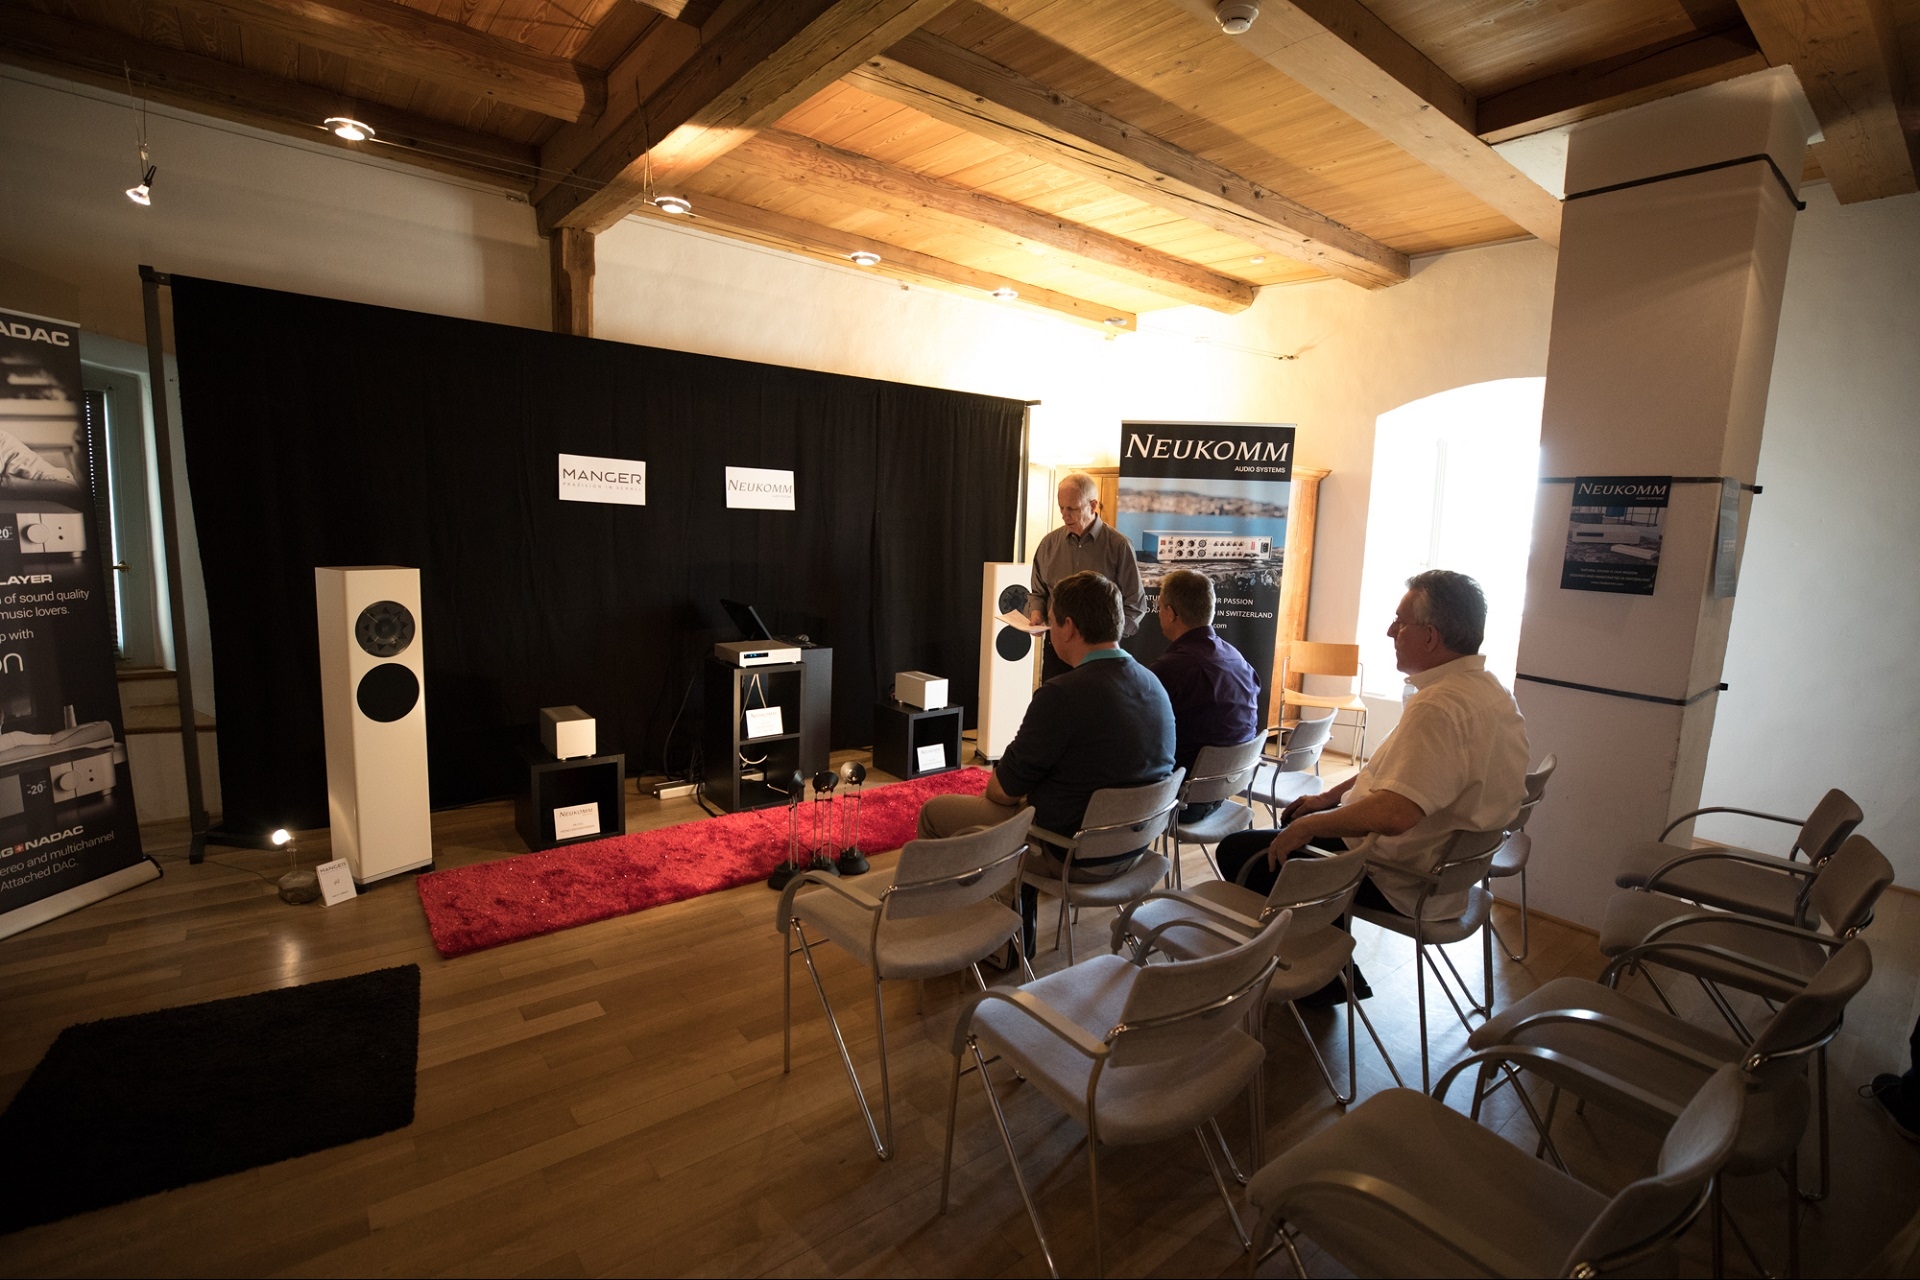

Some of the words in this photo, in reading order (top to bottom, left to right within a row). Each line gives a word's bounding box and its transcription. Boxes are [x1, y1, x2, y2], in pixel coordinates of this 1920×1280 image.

[1125, 433, 1290, 462] NEUKOMM
[563, 468, 642, 485] MANGER
[1234, 465, 1255, 473] AUDIO
[1255, 466, 1286, 474] SYSTEMS
[728, 479, 792, 493] NEUKOMM
[1578, 482, 1667, 495] NEUKOMM
[4, 593, 17, 605] of
[19, 591, 54, 604] sound
[56, 588, 90, 603] quality
[1223, 598, 1254, 606] PASSION
[0, 607, 34, 620] music
[35, 605, 70, 617] lovers.
[1225, 611, 1273, 619] SWITZERLAND
[8, 628, 34, 640] with
[559, 808, 593, 818] NEUKOMM
[25, 825, 84, 851] NADAC
[27, 851, 48, 868] and
[50, 830, 115, 861] multichannel
[1, 865, 51, 892] Attached
[53, 857, 79, 873] DAC.
